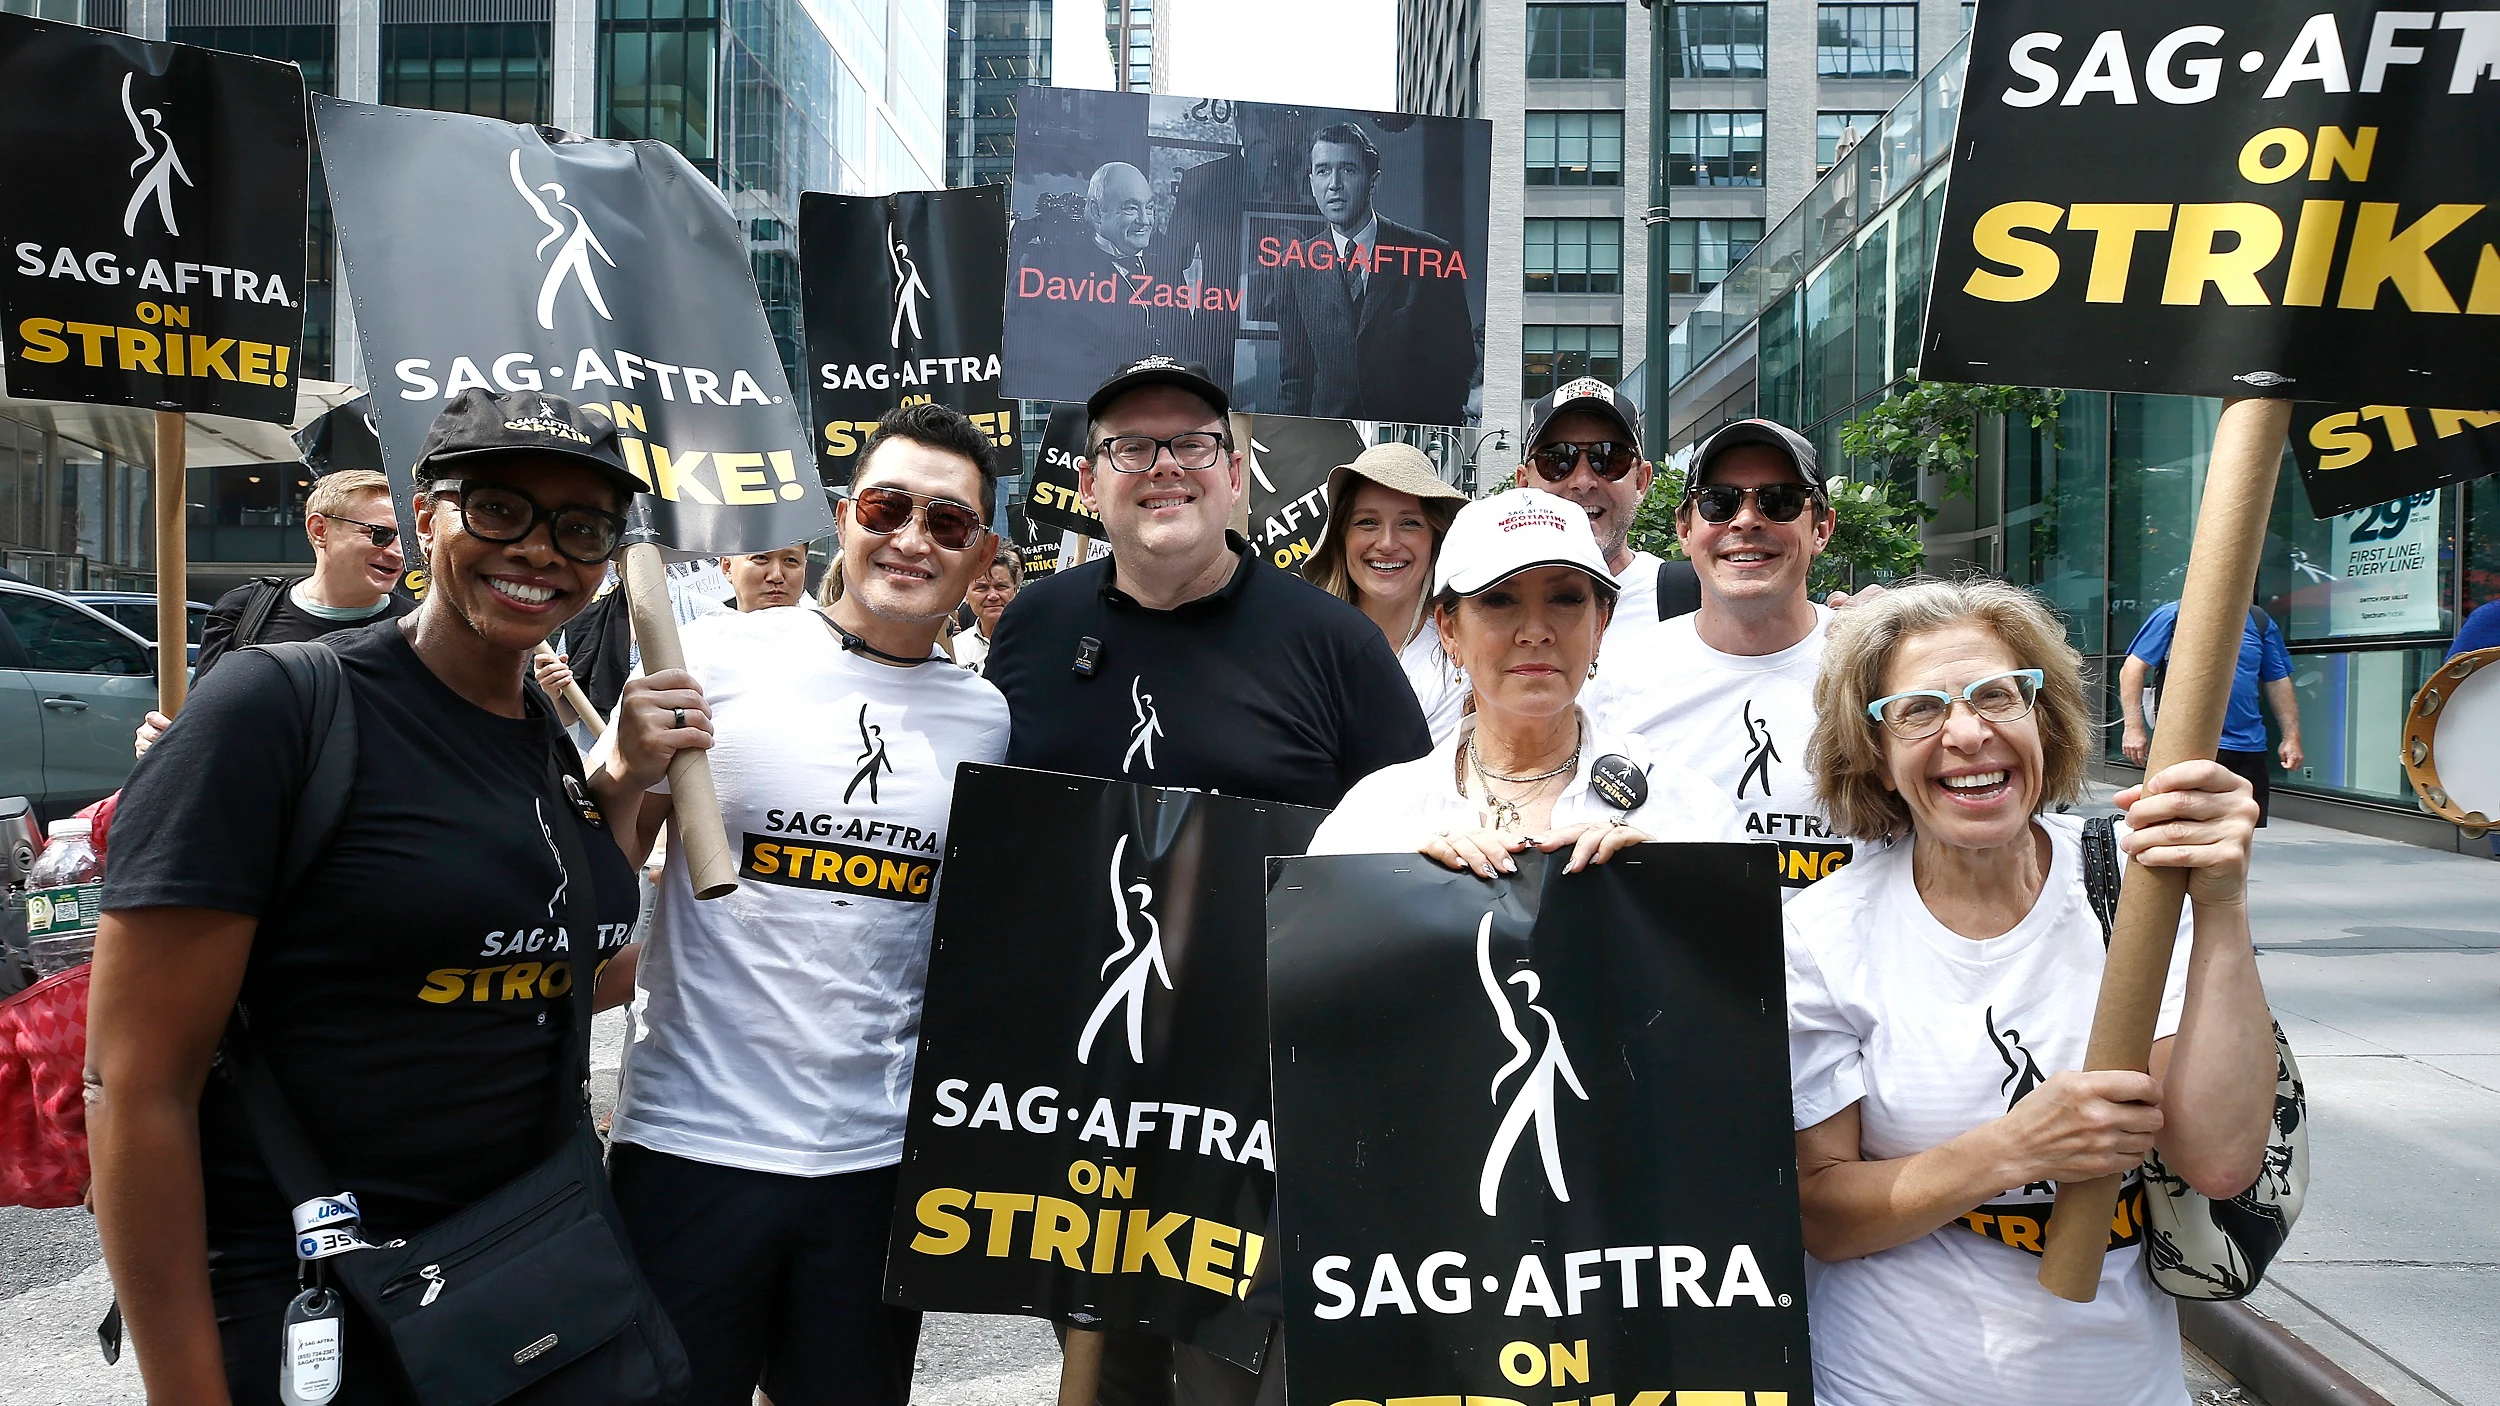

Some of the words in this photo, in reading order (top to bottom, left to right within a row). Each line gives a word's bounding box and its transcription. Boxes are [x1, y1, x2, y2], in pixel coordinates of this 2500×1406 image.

[2001, 11, 2500, 107] SAG·AFT
[2238, 126, 2379, 185] ON
[1258, 236, 1468, 280] SAG-AFTRA
[1963, 200, 2500, 315] STRIK
[1018, 267, 1117, 302] David
[1128, 274, 1245, 312] Zaslav
[136, 301, 190, 328] ON
[19, 317, 291, 388] STRIKE!
[503, 421, 592, 445] CAPTAIN
[1498, 515, 1567, 527] NEGOTIATING
[1503, 521, 1566, 533] COMMITTEE
[1274, 536, 1312, 569] ON
[2347, 562, 2390, 577] EVERY
[2390, 557, 2425, 573] LINE!
[2350, 548, 2385, 563] FIRST
[2387, 543, 2422, 559] LINE!
[1593, 775, 1633, 809] STRIKE!
[751, 842, 931, 895] STRONG
[1068, 1159, 1136, 1199] ON
[909, 1187, 1265, 1302] STRIKE!
[1498, 1339, 1591, 1388] ON
